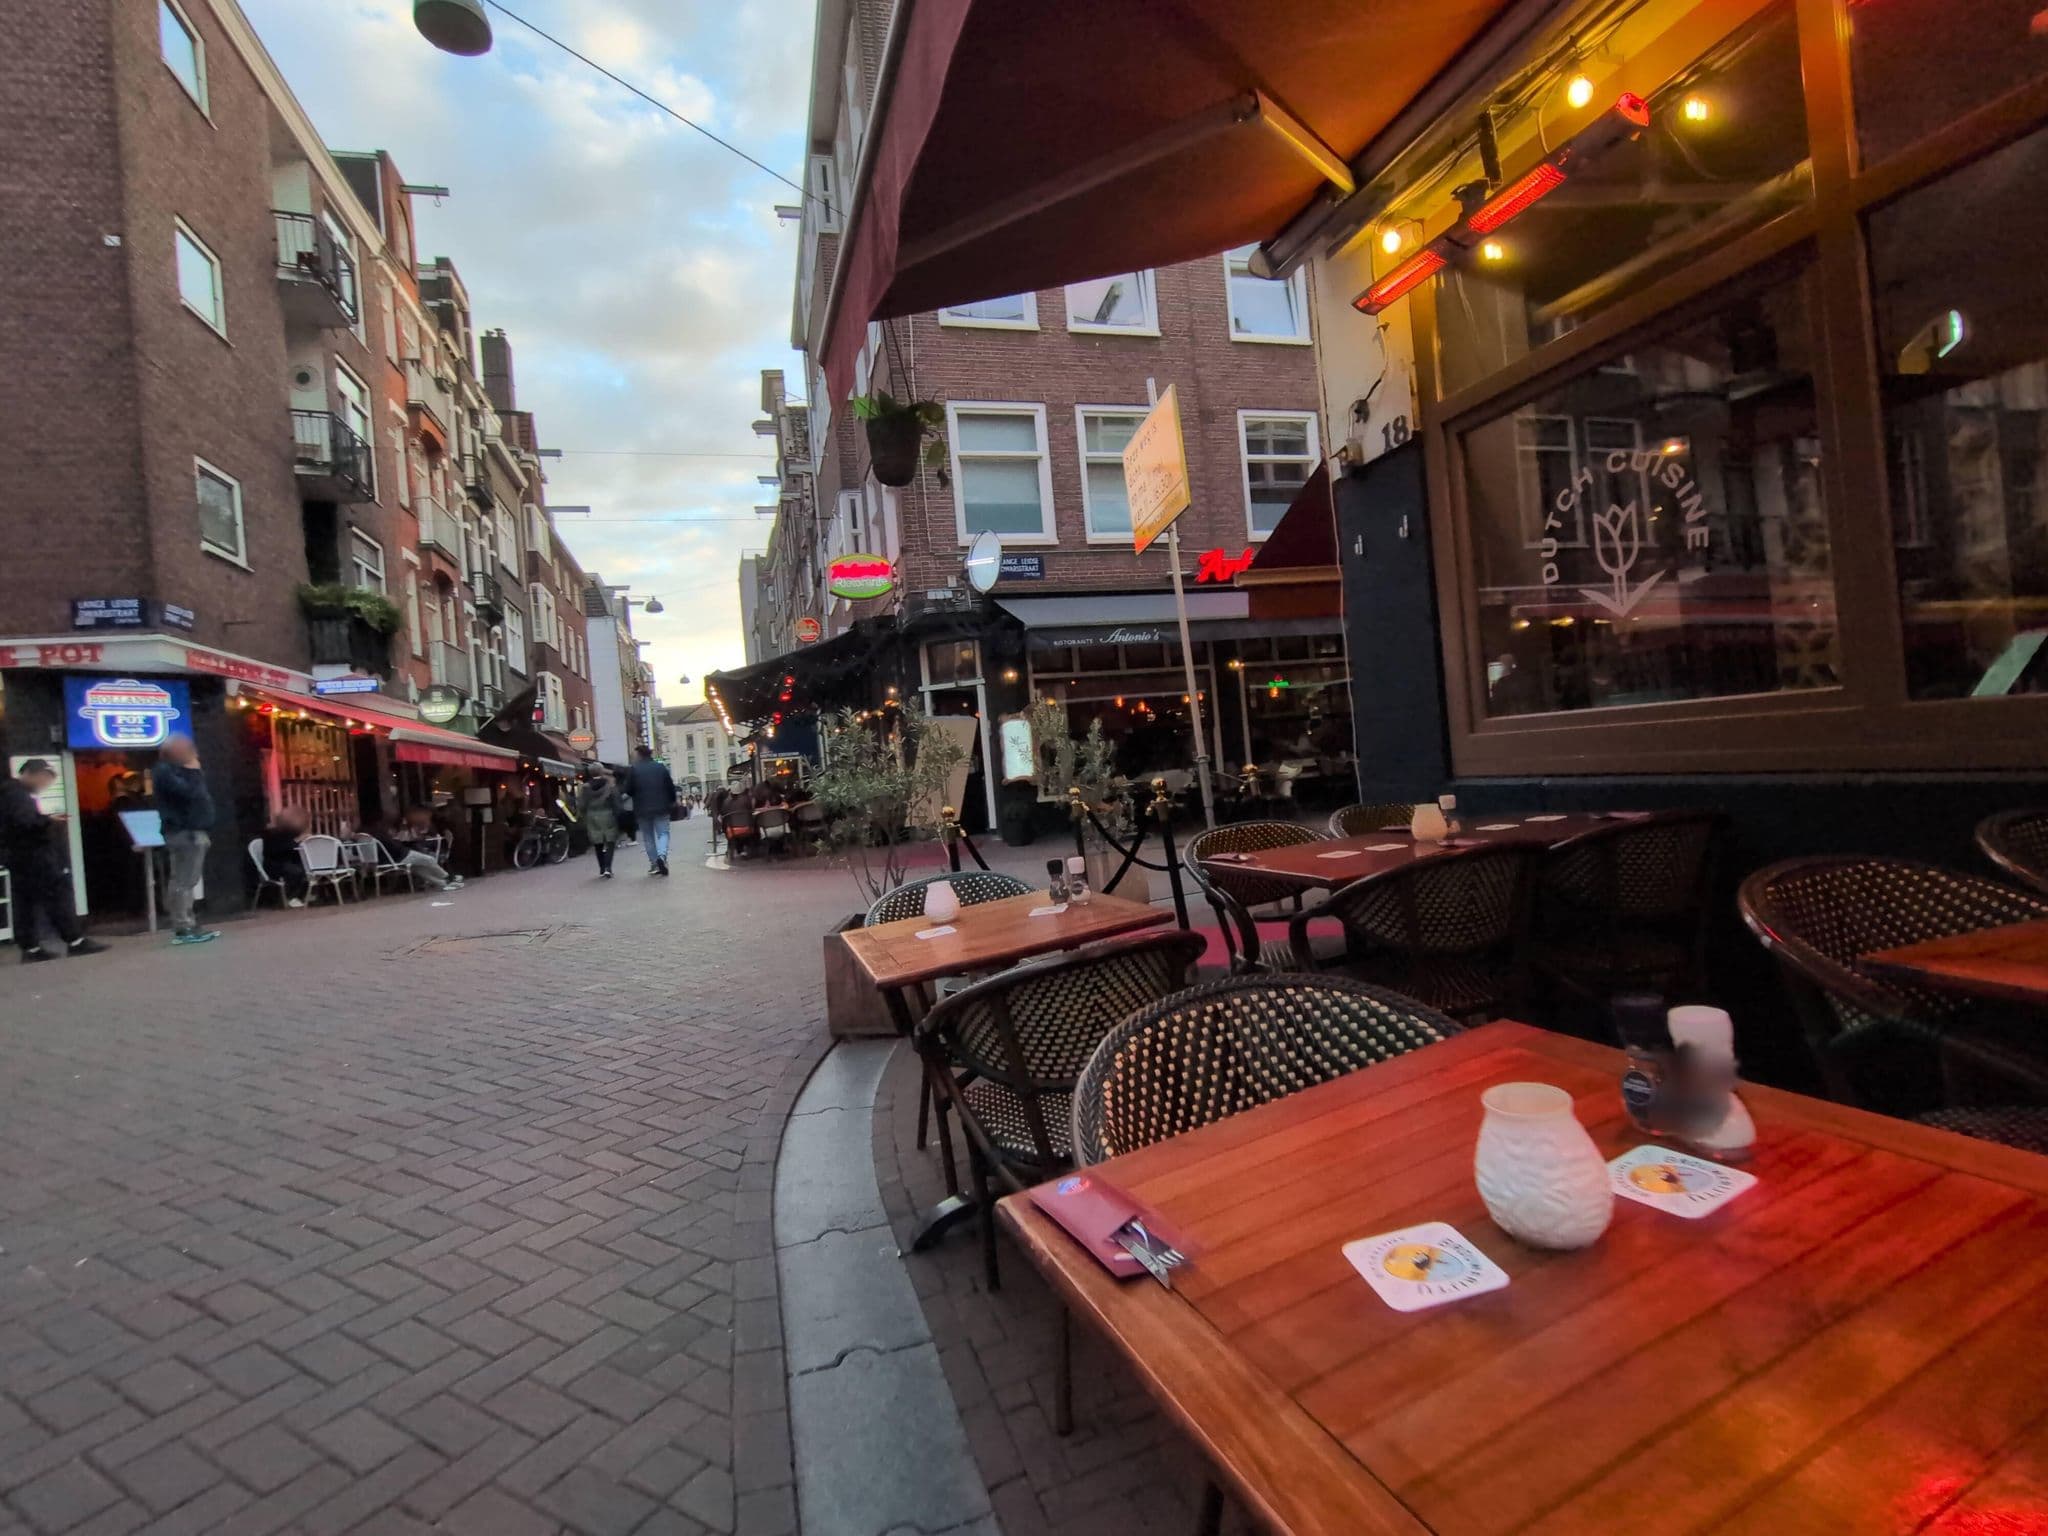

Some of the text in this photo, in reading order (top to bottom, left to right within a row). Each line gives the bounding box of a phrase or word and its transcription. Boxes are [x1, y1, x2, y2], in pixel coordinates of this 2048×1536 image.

[1382, 415, 1409, 451] 18
[1540, 450, 1710, 585] DUTCH CUISINE
[1100, 627, 1160, 643] Antonio's
[39, 644, 103, 667] POT
[117, 714, 147, 725] POT
